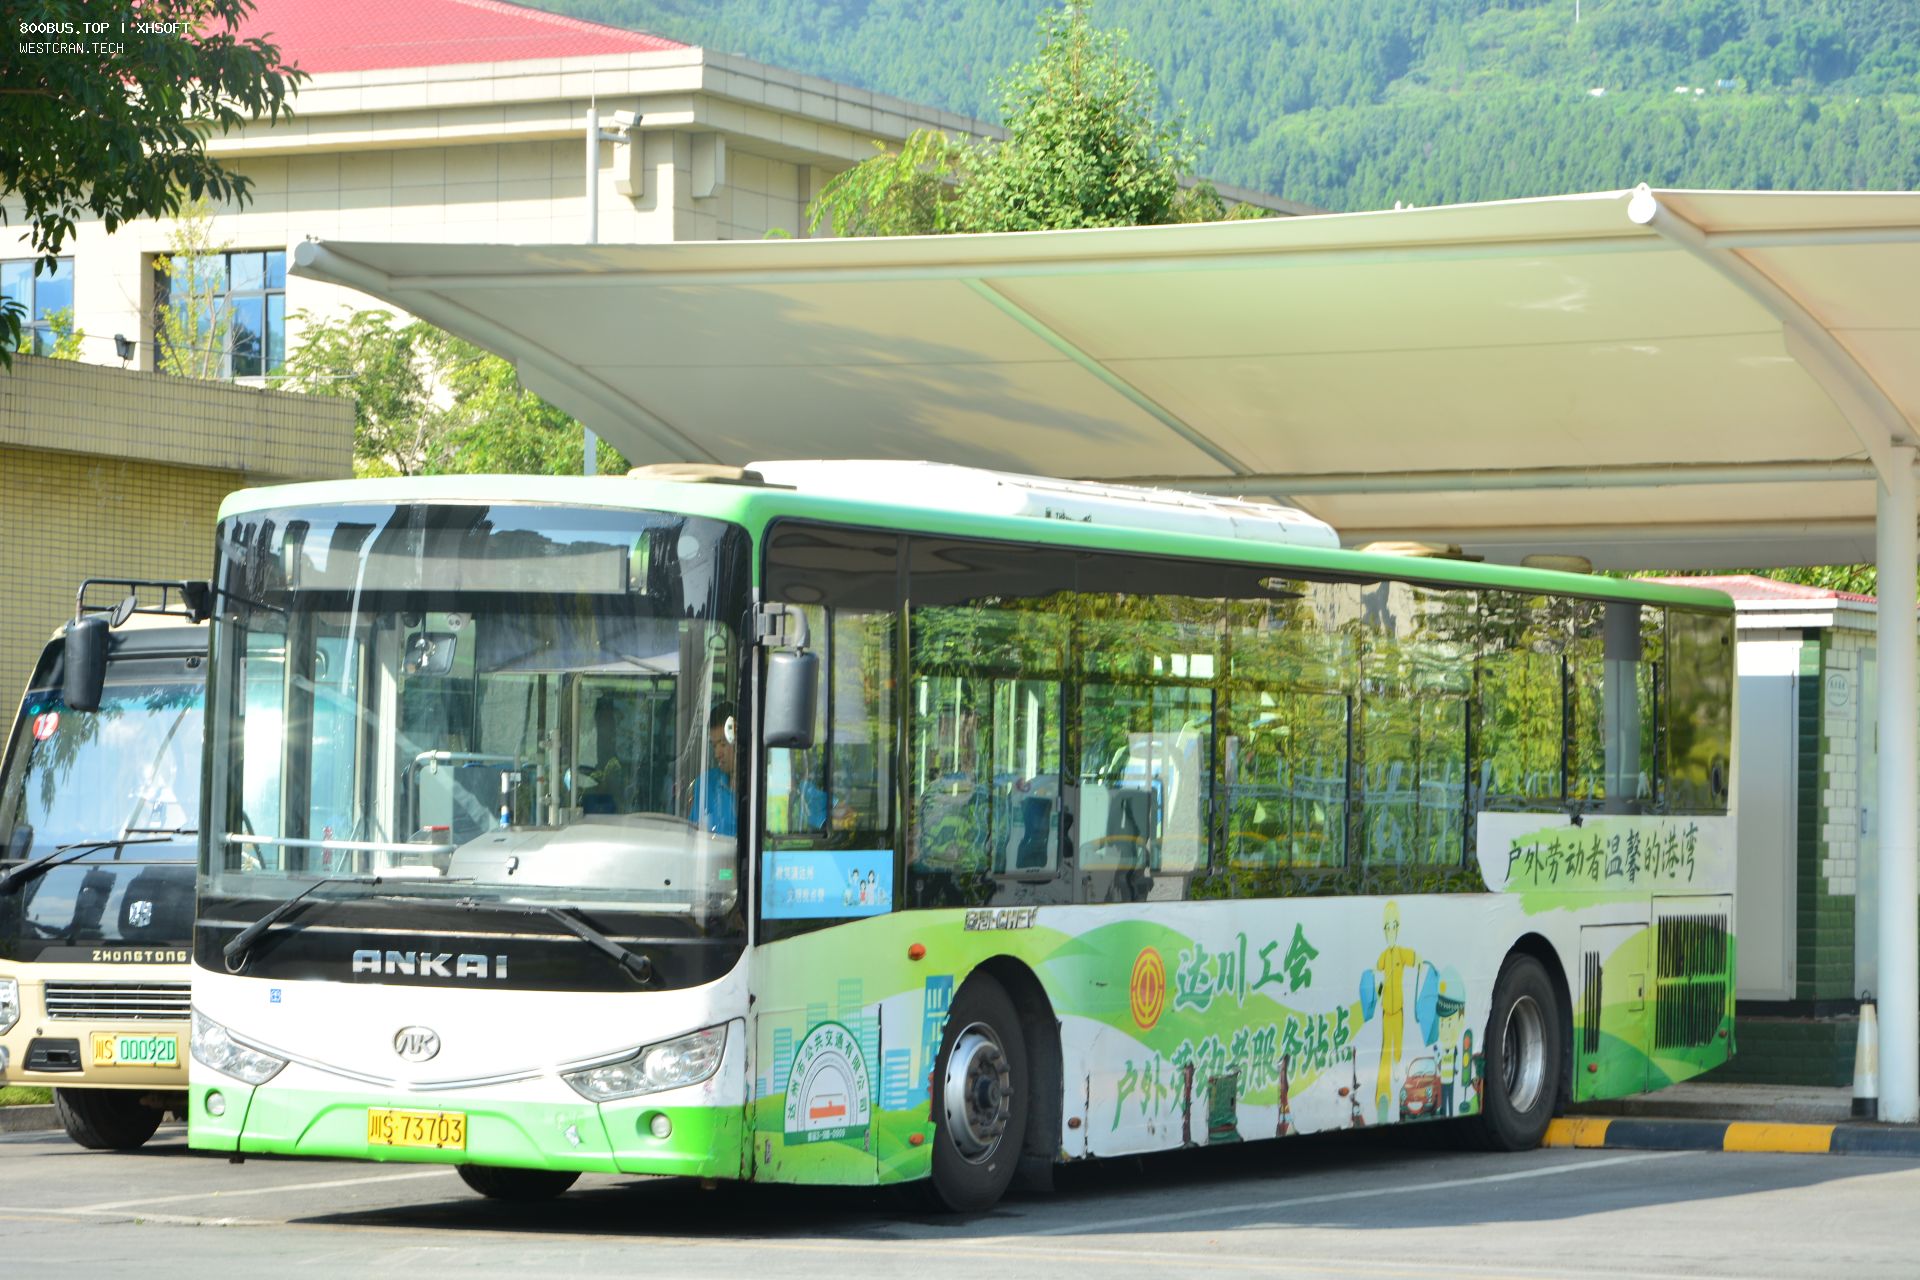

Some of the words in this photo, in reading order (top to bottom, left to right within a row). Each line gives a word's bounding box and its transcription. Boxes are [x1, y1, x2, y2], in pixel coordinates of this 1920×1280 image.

[37, 712, 58, 738] 12
[1504, 821, 1698, 886] 户外劳动者温馨的港湾
[92, 950, 187, 962] ZHONGTONG
[352, 949, 508, 979] ANKAI
[1174, 922, 1320, 1009] 达川工会
[1111, 1005, 1352, 1132] 户外劳动者服务站点
